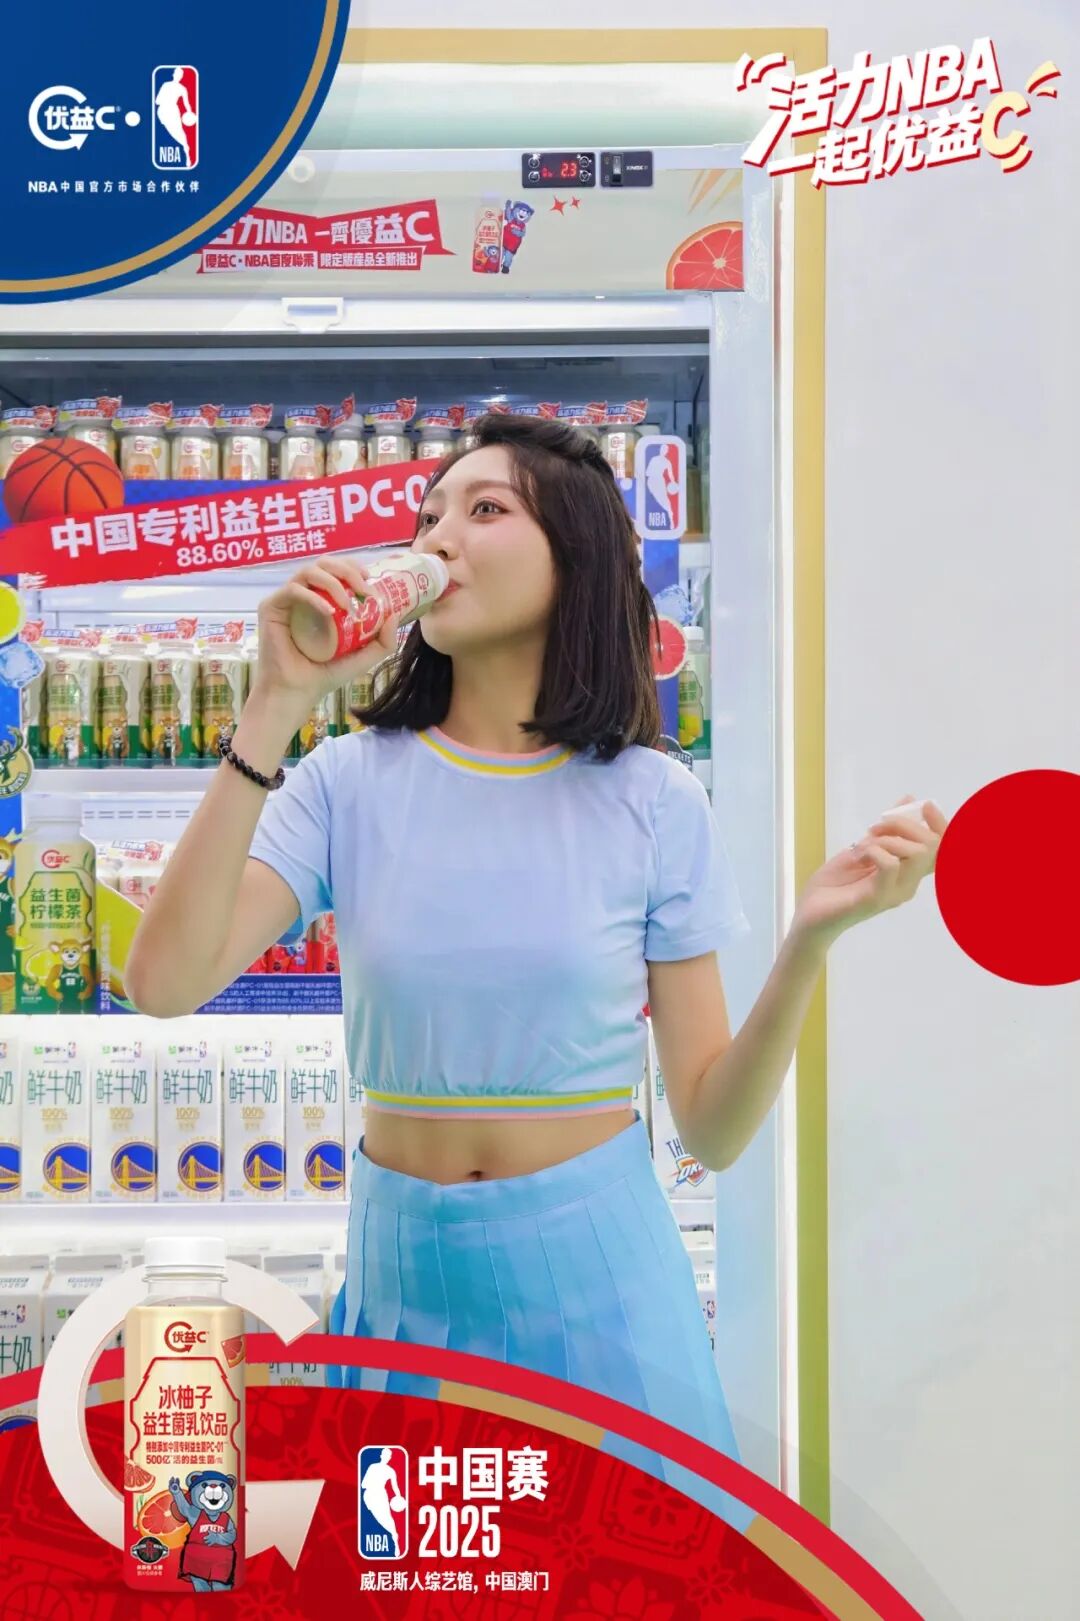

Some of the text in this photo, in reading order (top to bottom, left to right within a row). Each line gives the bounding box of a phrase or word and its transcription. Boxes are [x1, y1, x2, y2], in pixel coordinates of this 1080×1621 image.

[51, 473, 428, 559] 中国专利益生菌PC-0
[649, 512, 667, 527] NBA
[176, 538, 264, 568] 88.60%
[30, 887, 82, 903] 益生菌
[30, 904, 82, 920] 柠檬茶
[28, 1069, 83, 1105] 鲜牛奶
[96, 1069, 148, 1104] 鲜牛奶
[163, 1069, 213, 1104] 鲜牛奶
[229, 1068, 278, 1104] 鲜牛奶
[291, 1068, 338, 1104] 鲜牛奶
